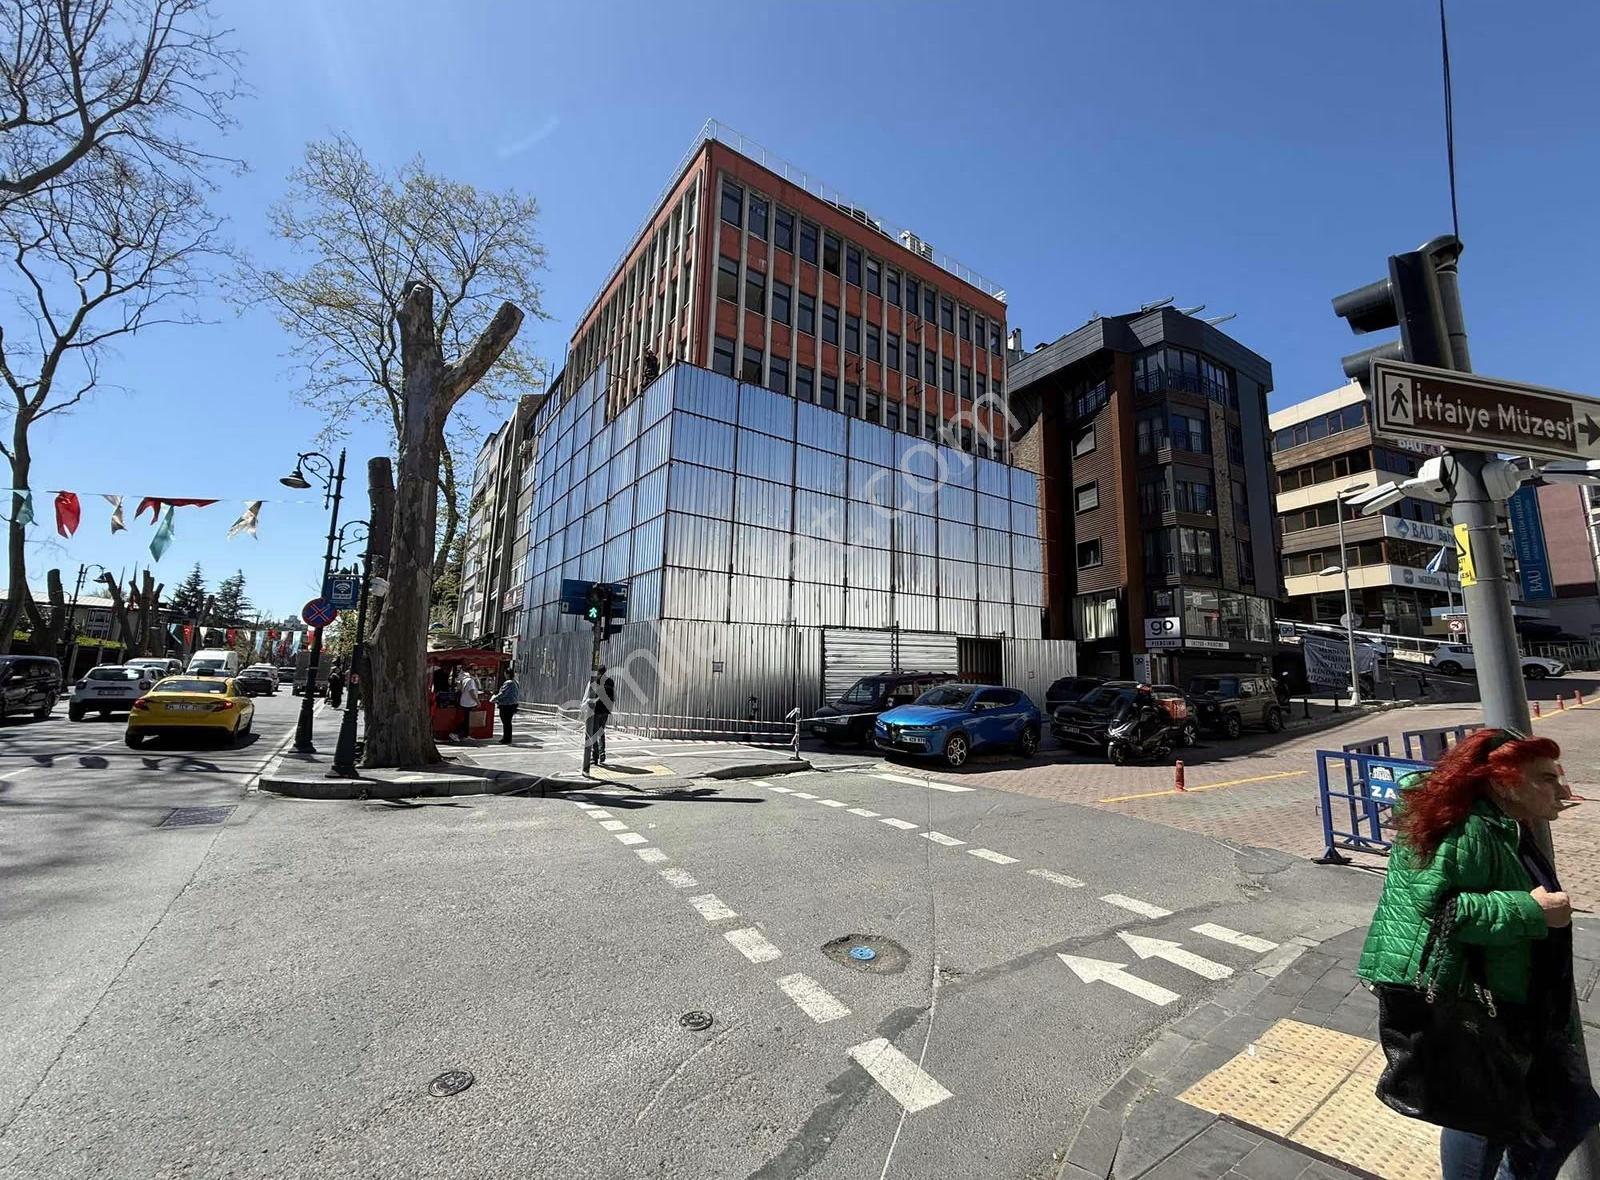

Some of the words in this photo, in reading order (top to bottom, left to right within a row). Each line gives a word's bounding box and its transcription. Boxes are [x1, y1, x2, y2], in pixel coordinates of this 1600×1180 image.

[1416, 382, 1490, 433] İtfaiye
[1497, 403, 1573, 441] Müzesi
[1411, 522, 1434, 540] BAU
[1527, 570, 1545, 592] BAU
[1150, 620, 1174, 636] go
[1370, 785, 1396, 799] ZA
